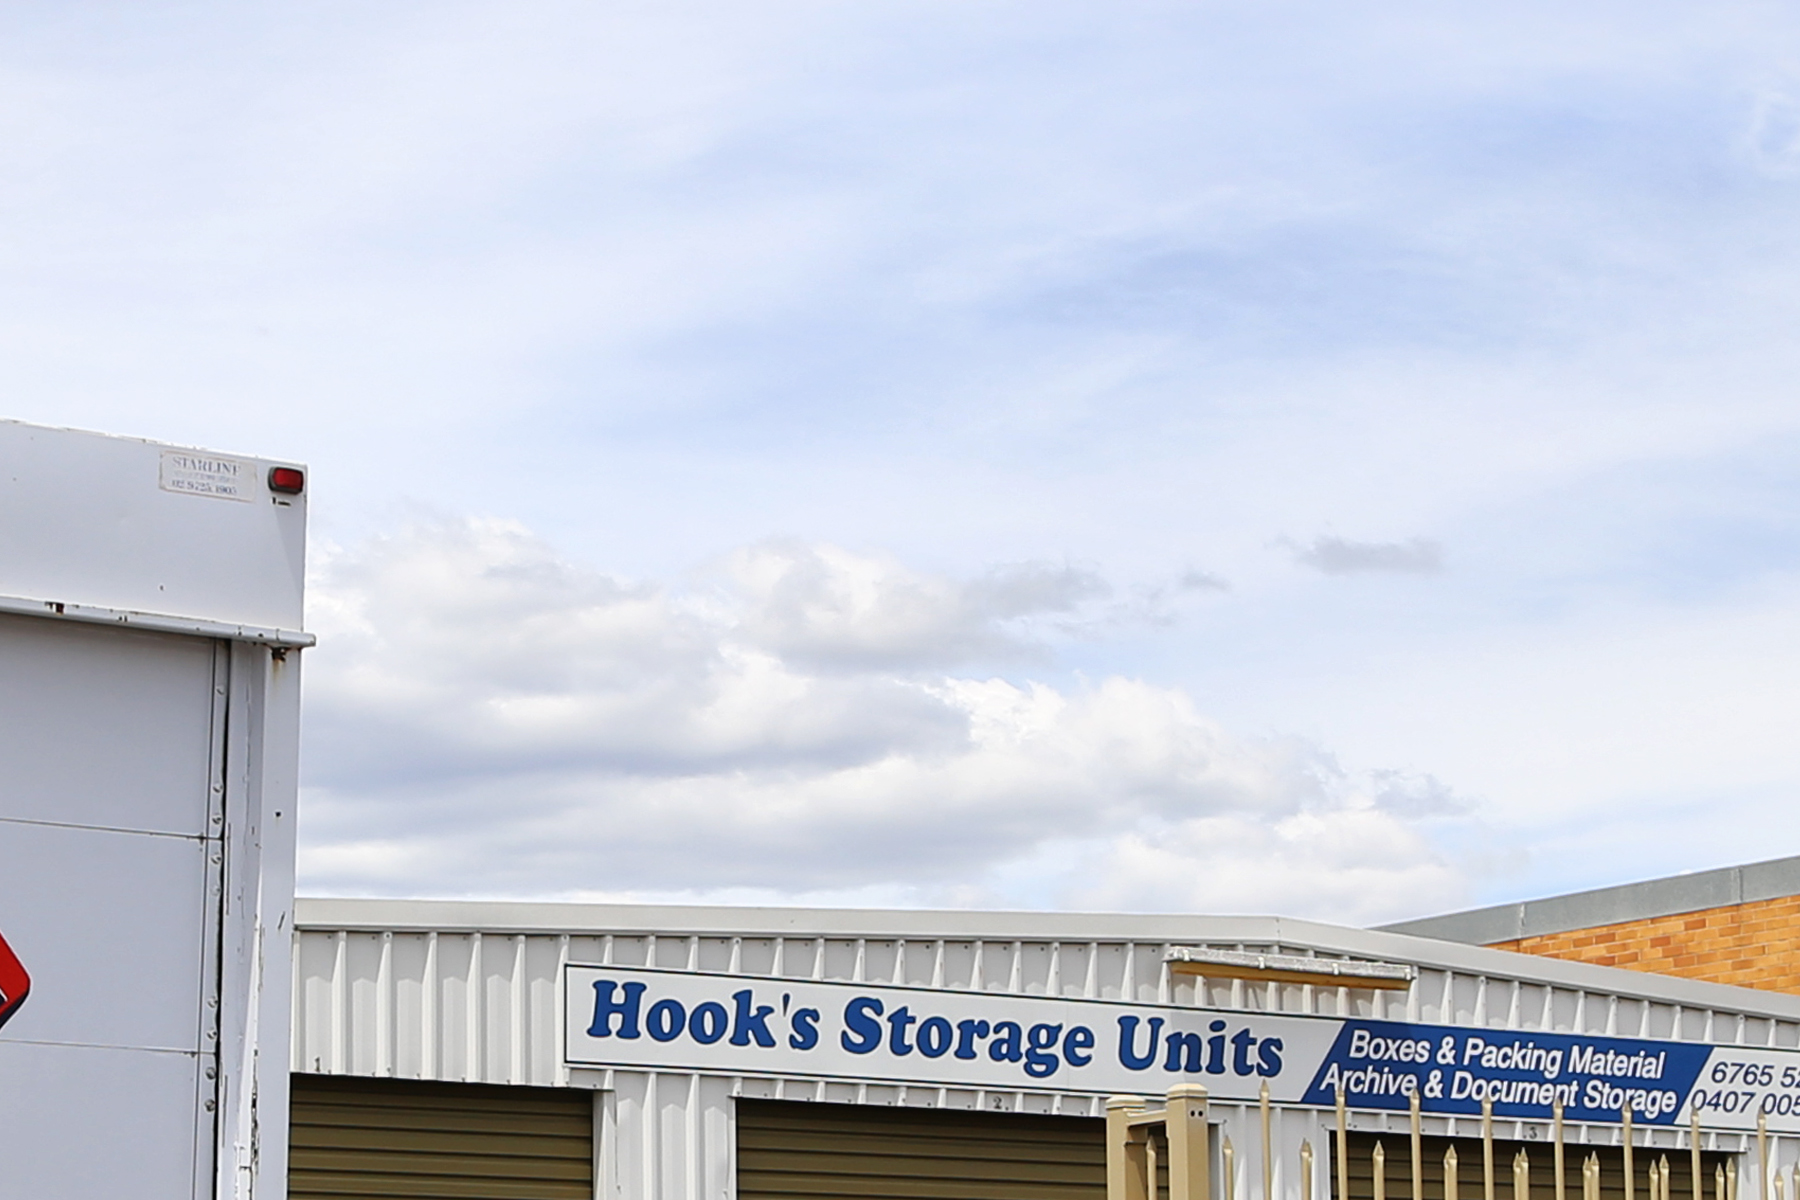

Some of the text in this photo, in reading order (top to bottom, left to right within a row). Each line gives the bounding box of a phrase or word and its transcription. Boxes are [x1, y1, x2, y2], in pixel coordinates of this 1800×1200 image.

[586, 980, 1285, 1078] Hook's Storage Units
[1349, 1029, 1666, 1079] Boxes & Packing Material
[1711, 1061, 1800, 1089] 6765 5
[993, 1096, 1002, 1109] 2
[1319, 1063, 1677, 1119] Archive & Document Storage
[1690, 1089, 1756, 1114] 0407
[1529, 1126, 1538, 1139] 3
